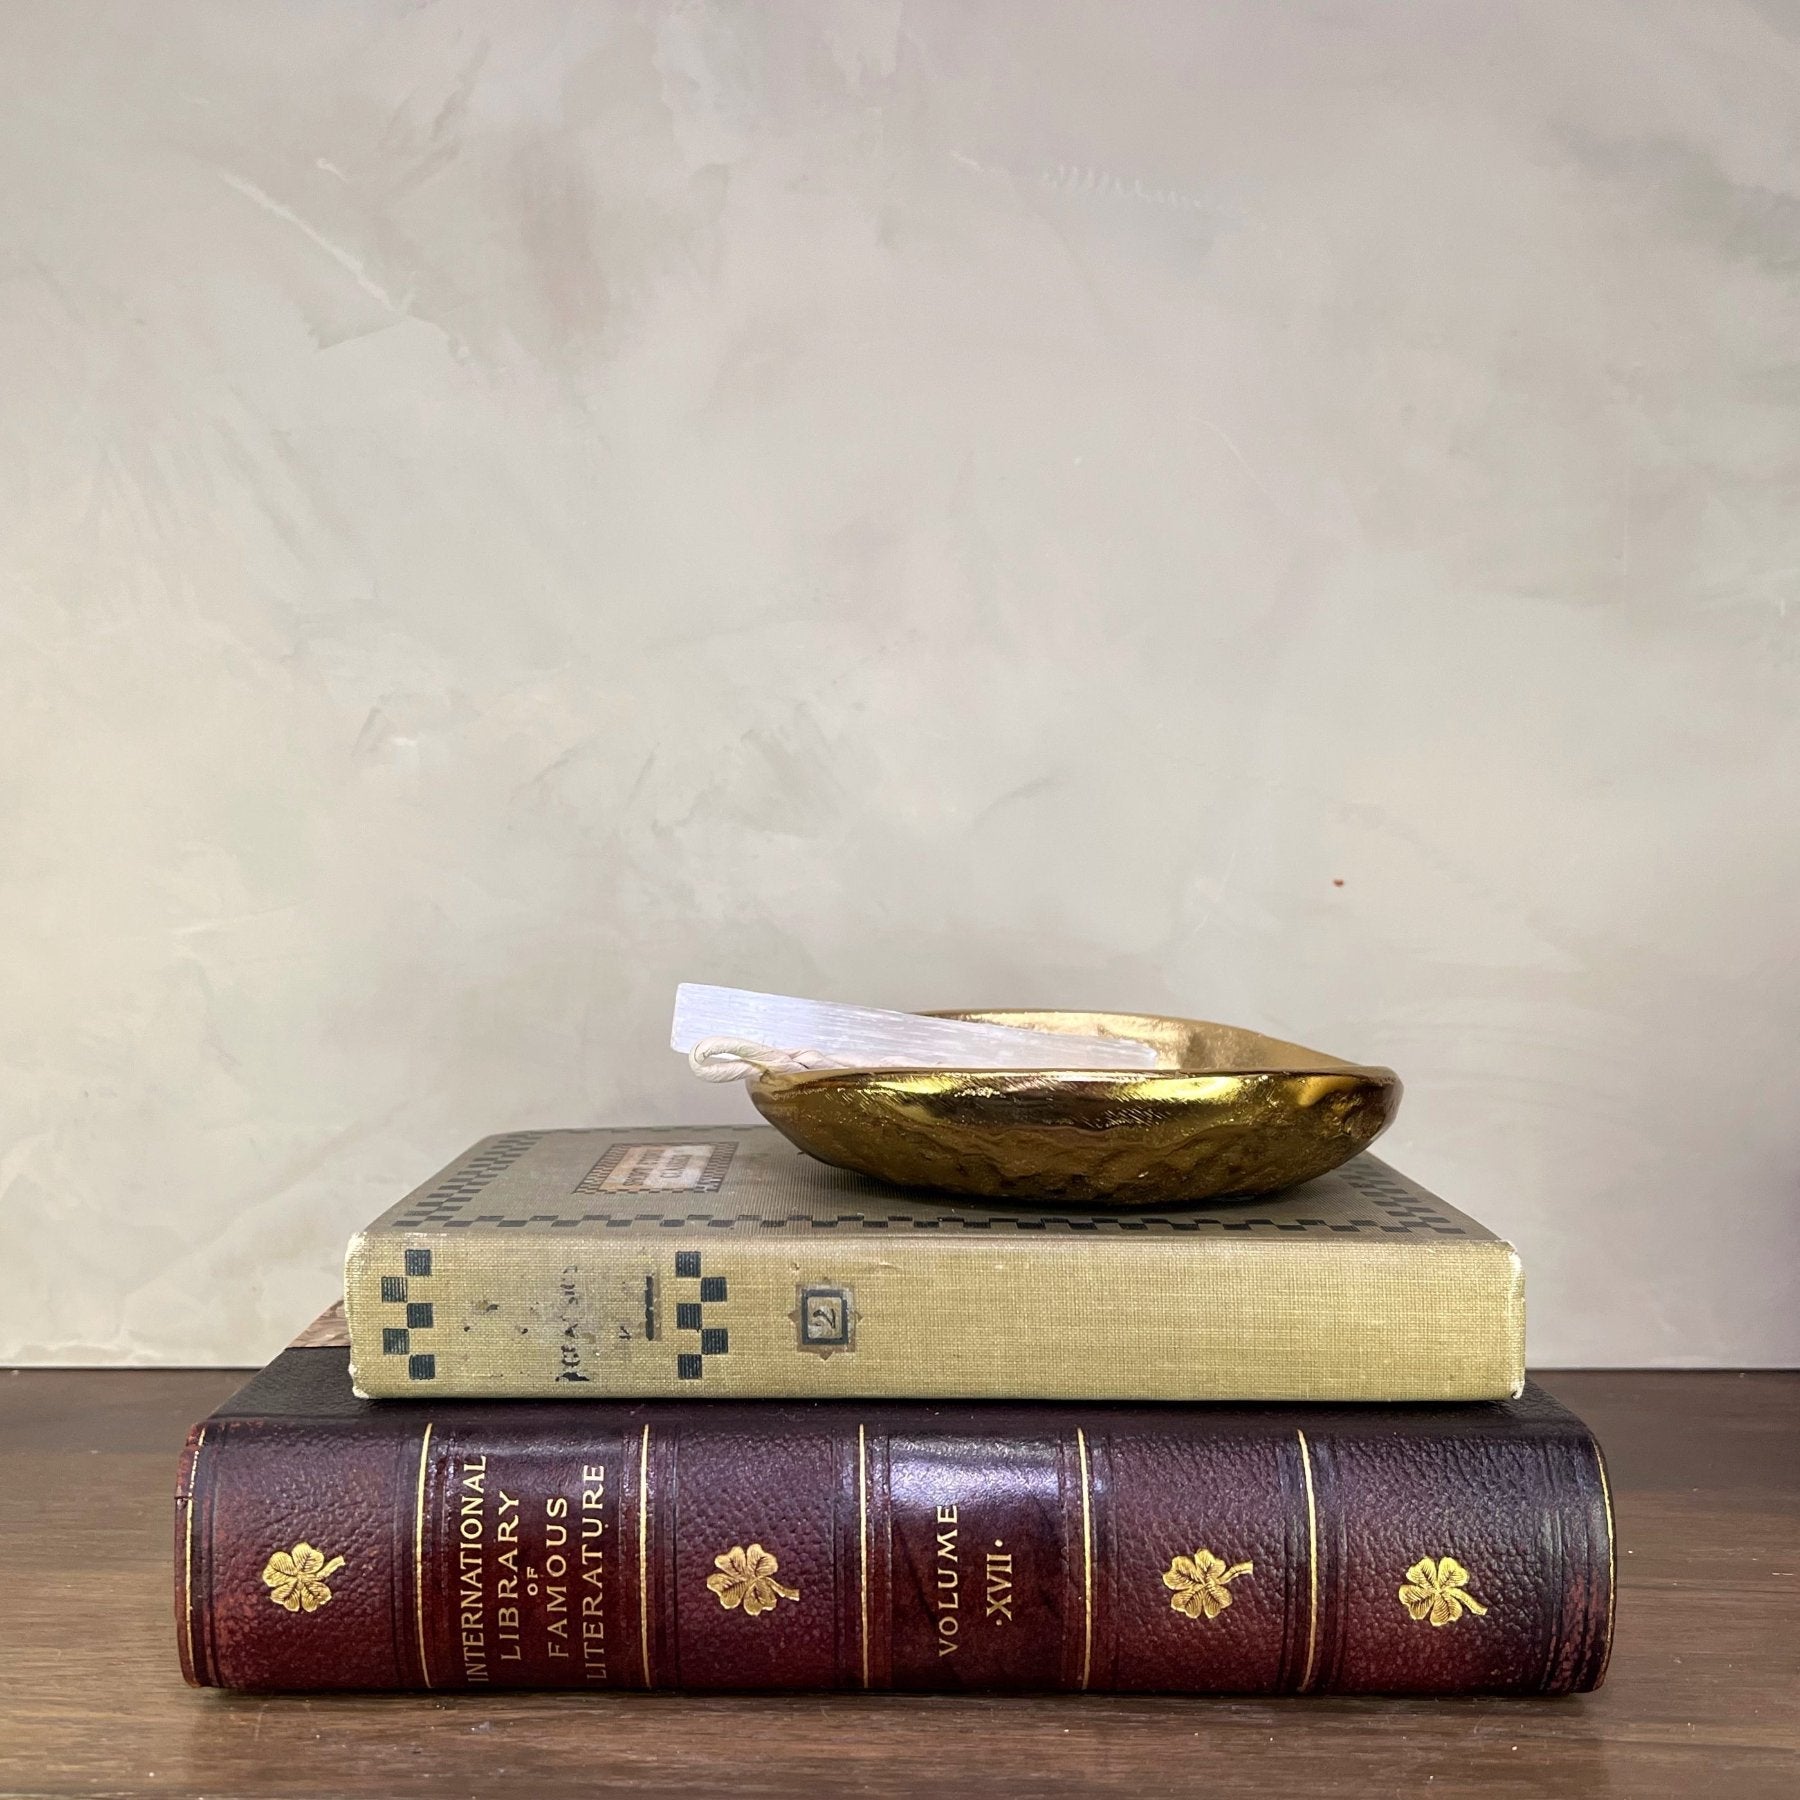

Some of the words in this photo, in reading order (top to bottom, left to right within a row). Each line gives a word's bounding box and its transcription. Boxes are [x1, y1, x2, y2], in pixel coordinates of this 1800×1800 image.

[460, 1455, 489, 1682] INTERNATIONAL
[498, 1491, 521, 1660] LIBRARY
[527, 1567, 538, 1596] OF
[546, 1498, 569, 1657] FAMOUS
[582, 1465, 605, 1679] LITERATURE
[937, 1505, 958, 1657] VOLUME
